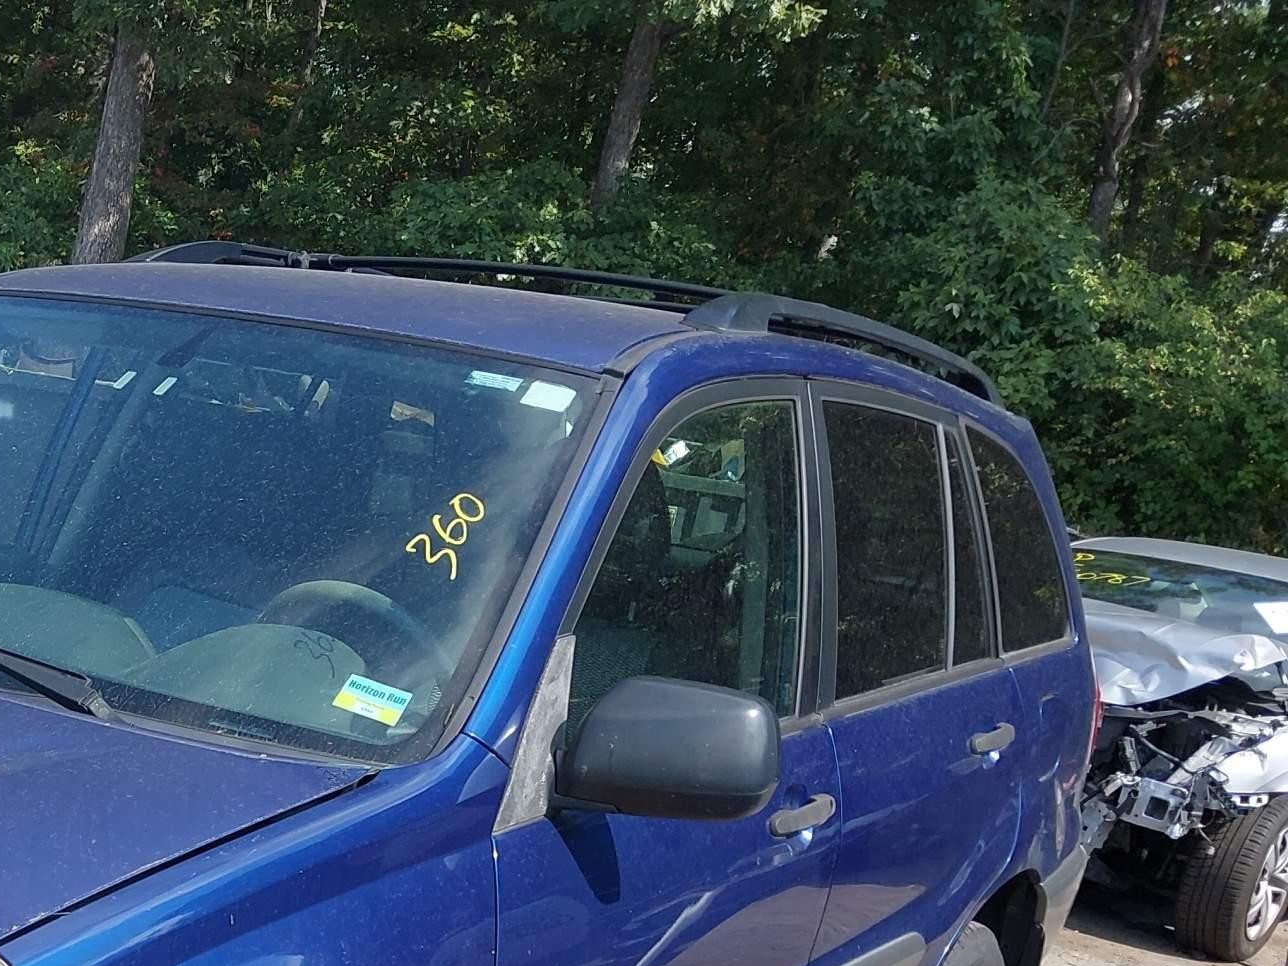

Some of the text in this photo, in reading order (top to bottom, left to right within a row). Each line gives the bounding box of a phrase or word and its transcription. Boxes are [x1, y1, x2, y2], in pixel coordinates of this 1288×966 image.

[405, 493, 485, 580] 360
[1074, 567, 1151, 586] 0787
[348, 680, 386, 699] Horizon
[387, 693, 407, 706] Run
